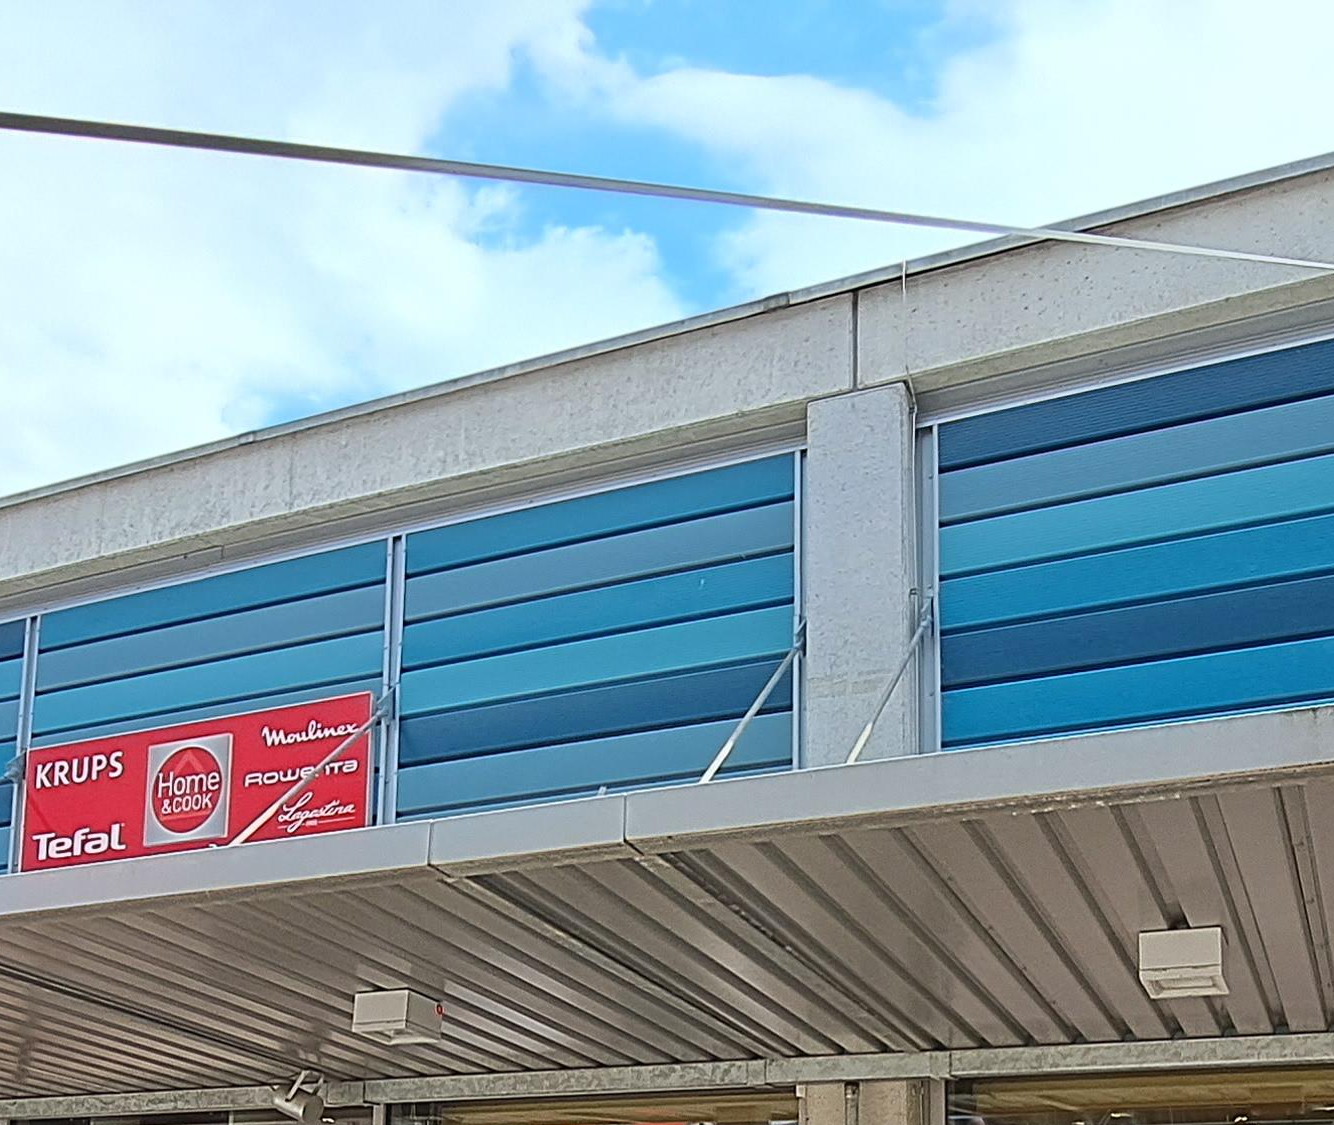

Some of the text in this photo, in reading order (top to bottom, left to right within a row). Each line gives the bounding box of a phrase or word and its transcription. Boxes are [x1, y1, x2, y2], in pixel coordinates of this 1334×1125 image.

[261, 719, 359, 747] Moulinex
[35, 751, 123, 789] KRUPS
[157, 766, 220, 798] Home
[161, 793, 213, 815] &COOK
[278, 791, 356, 833] Lagostina
[33, 823, 126, 861] Tefal
